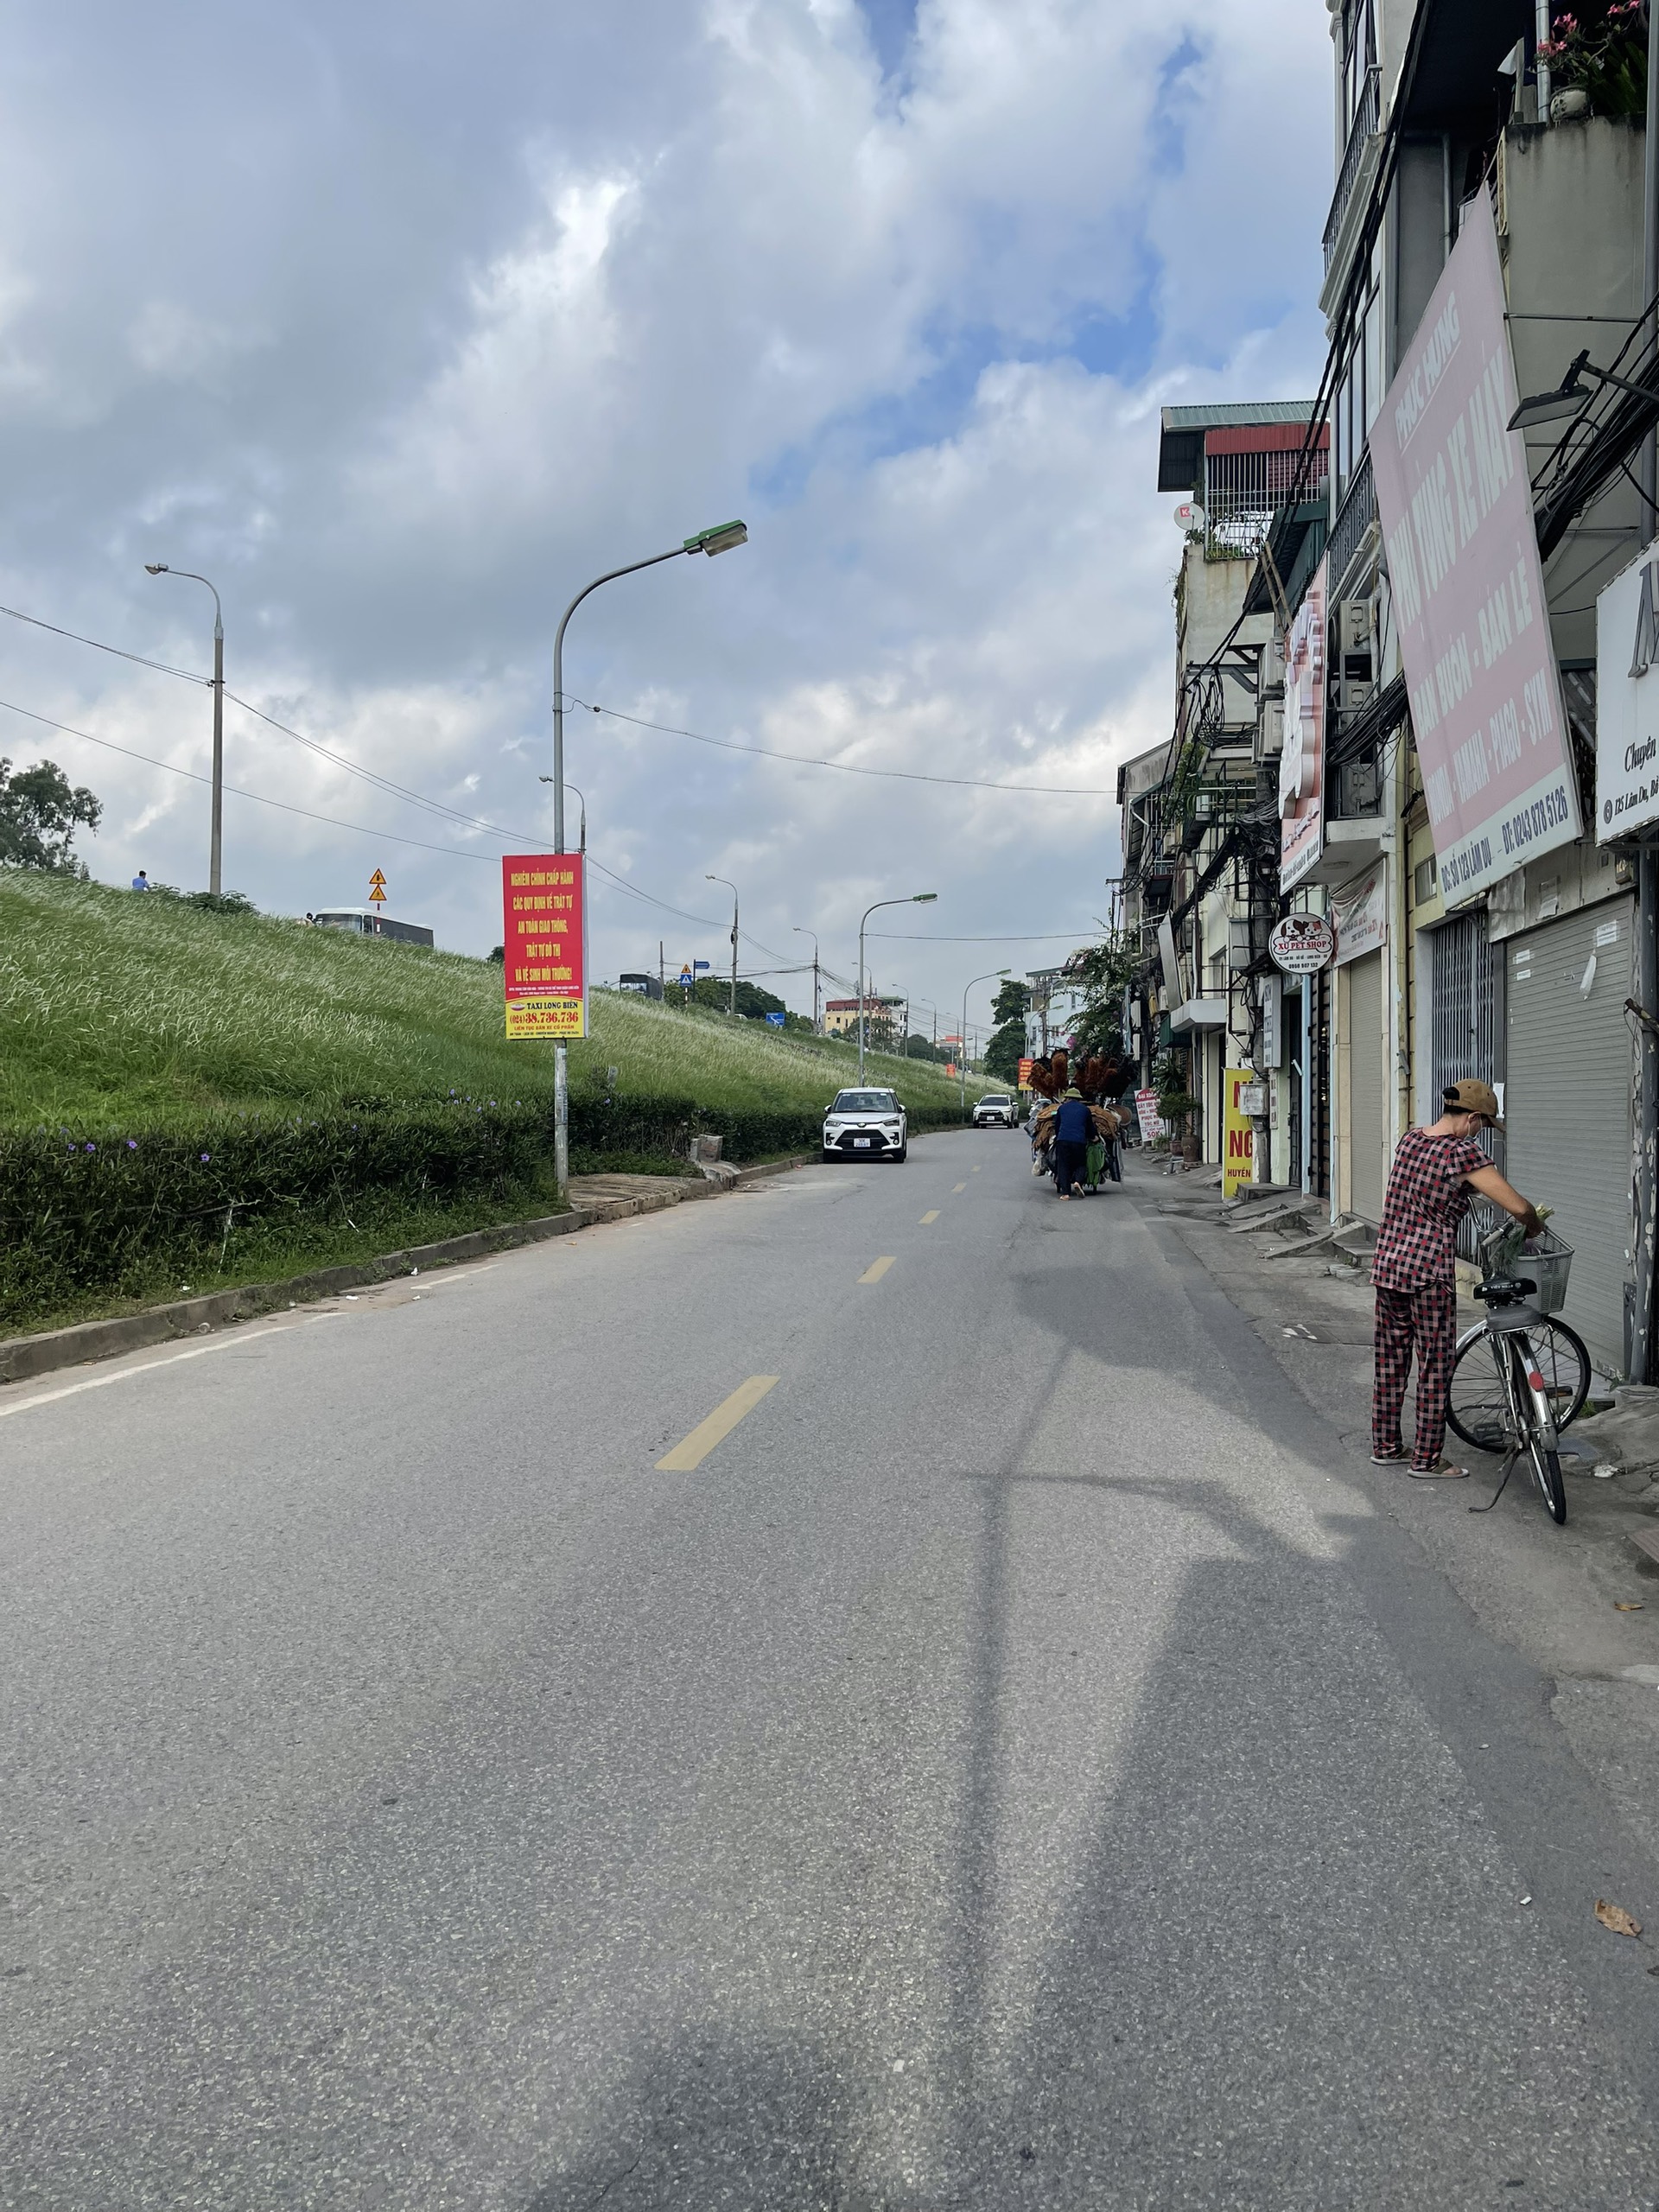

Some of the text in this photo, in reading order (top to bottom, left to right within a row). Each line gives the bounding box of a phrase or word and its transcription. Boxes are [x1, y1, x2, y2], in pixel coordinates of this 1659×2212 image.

[1412, 451, 1456, 601] TÙNG
[1447, 413, 1479, 550] XE
[1469, 340, 1514, 518] MÁY
[1478, 582, 1512, 670] BÁN
[1452, 729, 1490, 804] YAMAHA
[1523, 667, 1553, 746] SYM
[1624, 735, 1656, 772] Chuyên
[1624, 792, 1638, 810] Lâm
[1513, 810, 1532, 848] 0243
[1531, 799, 1547, 837] 878
[1546, 785, 1568, 828] 5126
[511, 867, 574, 887] NGHIÊM CHỈNH CHẤP HÀNH
[513, 894, 523, 910] CÁC
[524, 896, 533, 911] QUY
[534, 896, 546, 912] ĐỊNH
[553, 893, 565, 912] TRẬT
[566, 894, 573, 912] TỰ
[518, 920, 524, 934] AN
[525, 918, 538, 933] TOÀN
[539, 920, 550, 933] GIAO
[526, 941, 537, 960] TRẬT
[538, 943, 545, 960] TỰ
[515, 965, 522, 982] VÀ
[522, 965, 529, 984] VỆ
[530, 968, 541, 982] SINH
[542, 965, 551, 981] MÔI
[563, 1000, 578, 1008] BIÊN
